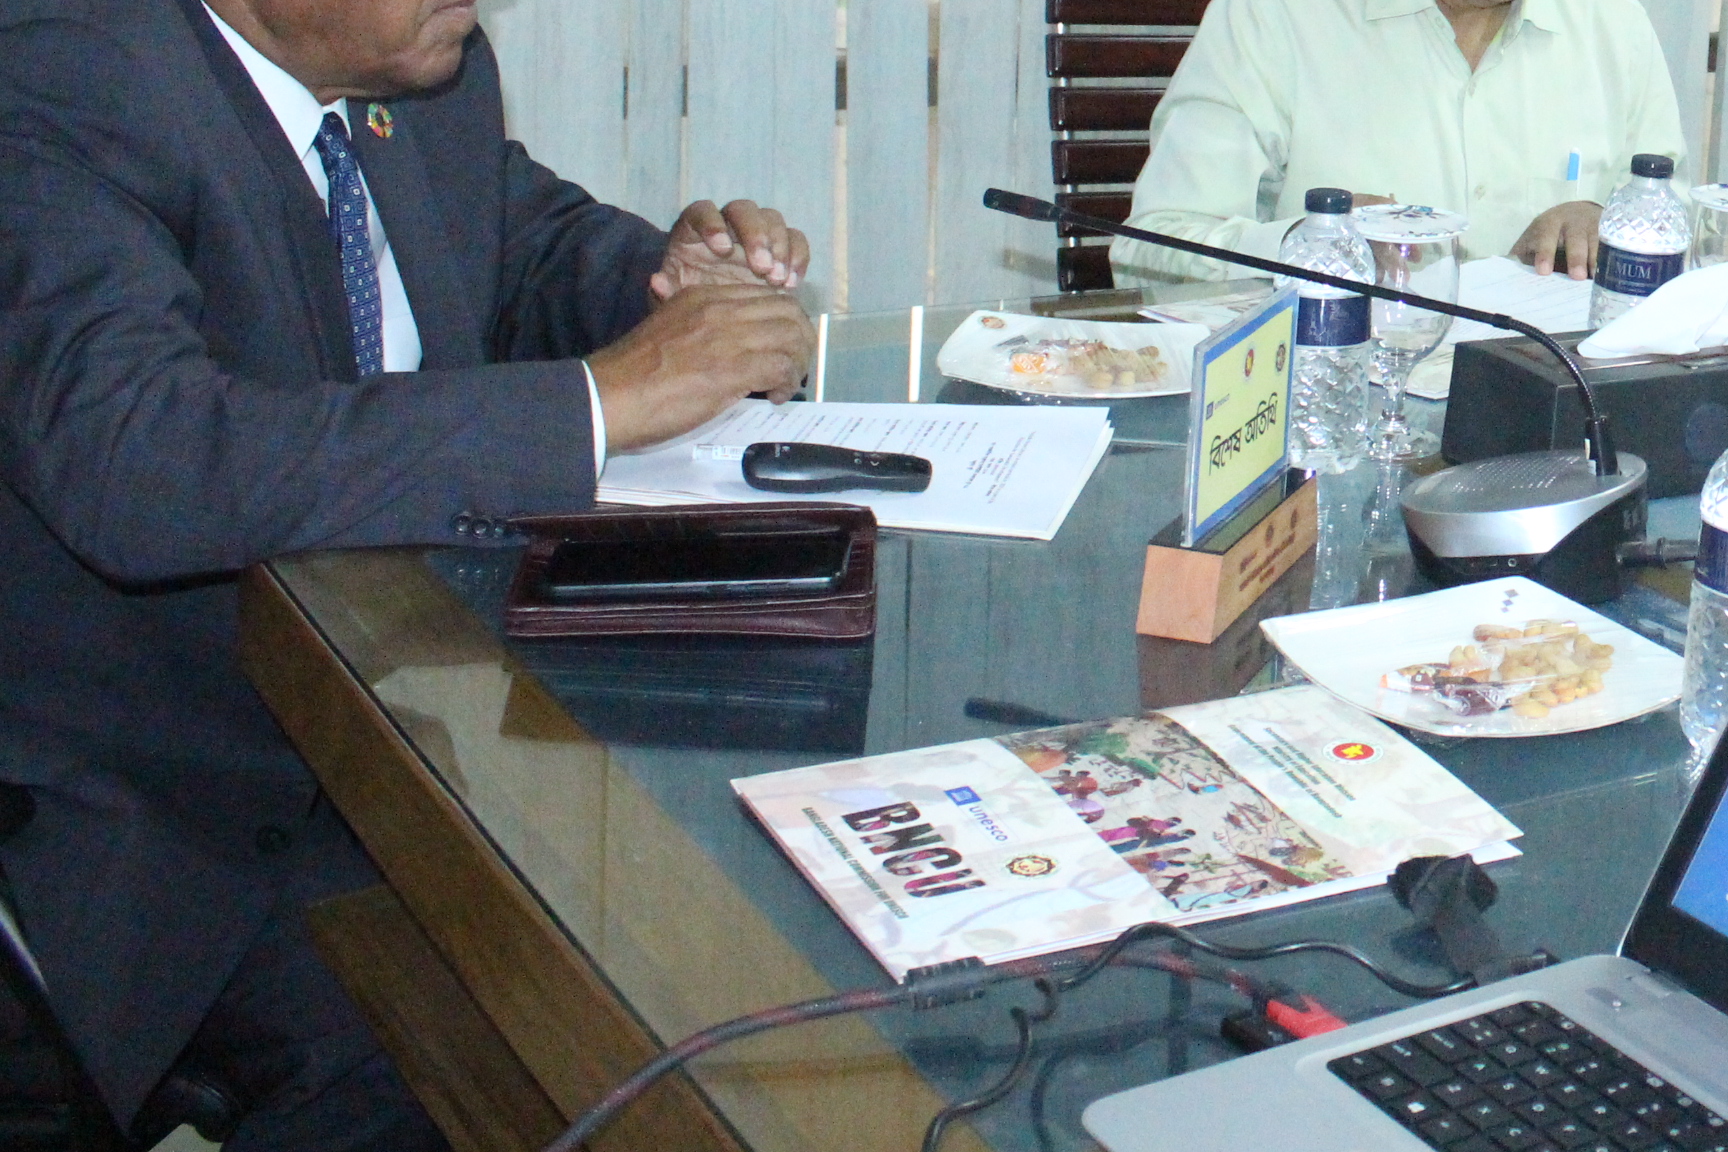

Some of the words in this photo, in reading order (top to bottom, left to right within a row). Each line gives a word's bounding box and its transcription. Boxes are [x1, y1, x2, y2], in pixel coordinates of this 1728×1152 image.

[1614, 260, 1652, 280] MUM
[1208, 426, 1242, 476] বিশেষ
[1245, 392, 1278, 444] অতিথি
[841, 801, 986, 898] BNCU
[968, 805, 1008, 842] unesco
